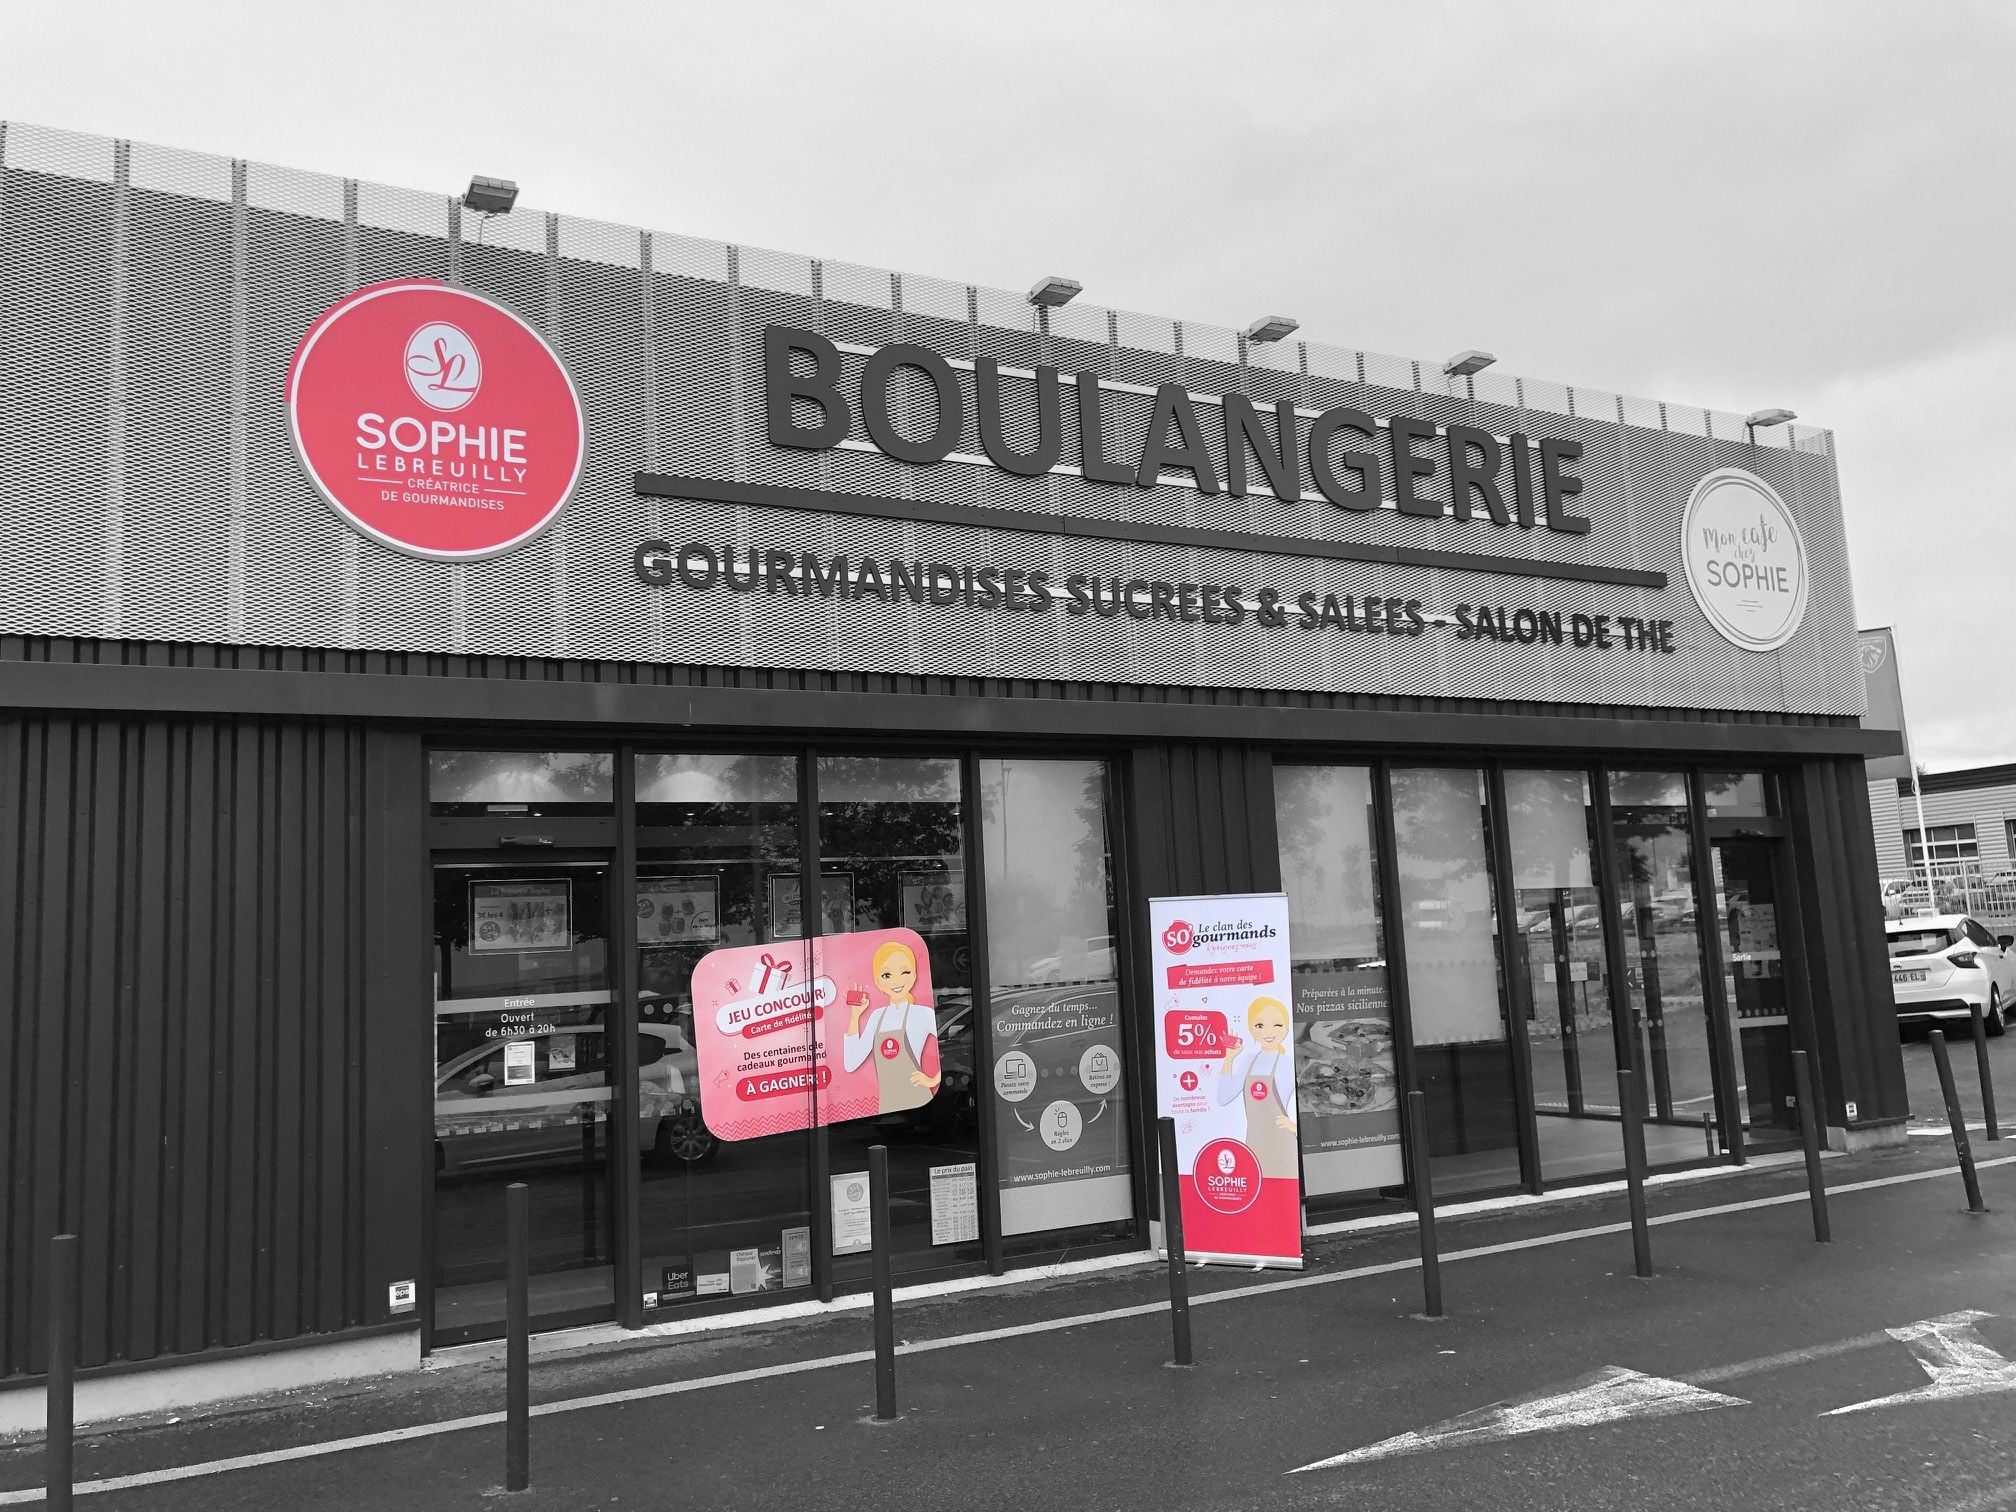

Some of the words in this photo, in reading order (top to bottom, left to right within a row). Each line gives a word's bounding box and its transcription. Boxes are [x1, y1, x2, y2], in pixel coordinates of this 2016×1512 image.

[356, 412, 527, 464] SOPHIE
[765, 325, 1590, 534] BOULANGERIE
[357, 453, 527, 483] LEBREUILLY
[407, 477, 480, 494] CRÉATRICE
[381, 490, 398, 502] DE
[402, 491, 505, 511] GOURMANDISES
[1703, 527, 1736, 553] Mon
[1734, 544, 1756, 563] chez
[1706, 560, 1789, 593] SOPHIE
[634, 539, 1052, 612] GOURMANDISES
[1066, 572, 1245, 625] SUCREES
[1257, 585, 1288, 627] &
[1299, 590, 1426, 636] SALEES
[1456, 602, 1563, 647] SALON
[1572, 611, 1611, 650] DE
[1619, 616, 1676, 654] THE
[1198, 923, 1210, 933] Le
[1212, 921, 1234, 931] clan
[1237, 919, 1253, 930] des
[1192, 925, 1276, 948] gourmands
[1185, 967, 1218, 977] Demandez
[1219, 966, 1236, 974] votre
[1236, 964, 1254, 973] carte
[1178, 977, 1188, 986] de
[1213, 975, 1219, 984] à
[1219, 974, 1237, 983] notre
[1237, 973, 1258, 984] équipe
[1301, 988, 1339, 1000] Préparées
[1340, 986, 1346, 997] à
[1347, 986, 1355, 996] la
[504, 997, 535, 1008] Entrée
[728, 1008, 751, 1025] JEU
[754, 987, 826, 1017] CONCOUR
[1011, 1004, 1046, 1018] Gagnez
[1048, 1002, 1060, 1014] du
[1062, 1002, 1098, 1015] temps...
[1296, 1002, 1314, 1014] Nos
[1316, 1001, 1345, 1015] pizzas
[500, 1012, 535, 1023] Ouvert
[750, 1023, 772, 1035] Carte
[773, 1020, 783, 1028] de
[784, 1011, 812, 1026] fidélité
[996, 1019, 1063, 1032] Commandez
[1065, 1019, 1078, 1028] en
[1081, 1014, 1106, 1030] ligne
[1109, 1013, 1114, 1025] !
[485, 1026, 498, 1037] de
[500, 1025, 526, 1036] 6h30
[528, 1024, 535, 1034] à
[536, 1023, 556, 1034] 20h
[1177, 1023, 1217, 1046] 5%
[744, 1051, 761, 1061] Des
[763, 1044, 806, 1058] centaines
[737, 1059, 775, 1072] cadeaux
[746, 1080, 756, 1096] À
[821, 1070, 827, 1083] !
[1320, 1132, 1400, 1148] www.sophie-lebreuilly.com
[1013, 1164, 1111, 1182] www.sophie-lebreuilly.com
[1207, 1175, 1248, 1188] SOPHIE
[667, 1271, 689, 1281] Uber
[667, 1281, 689, 1290] Eats
